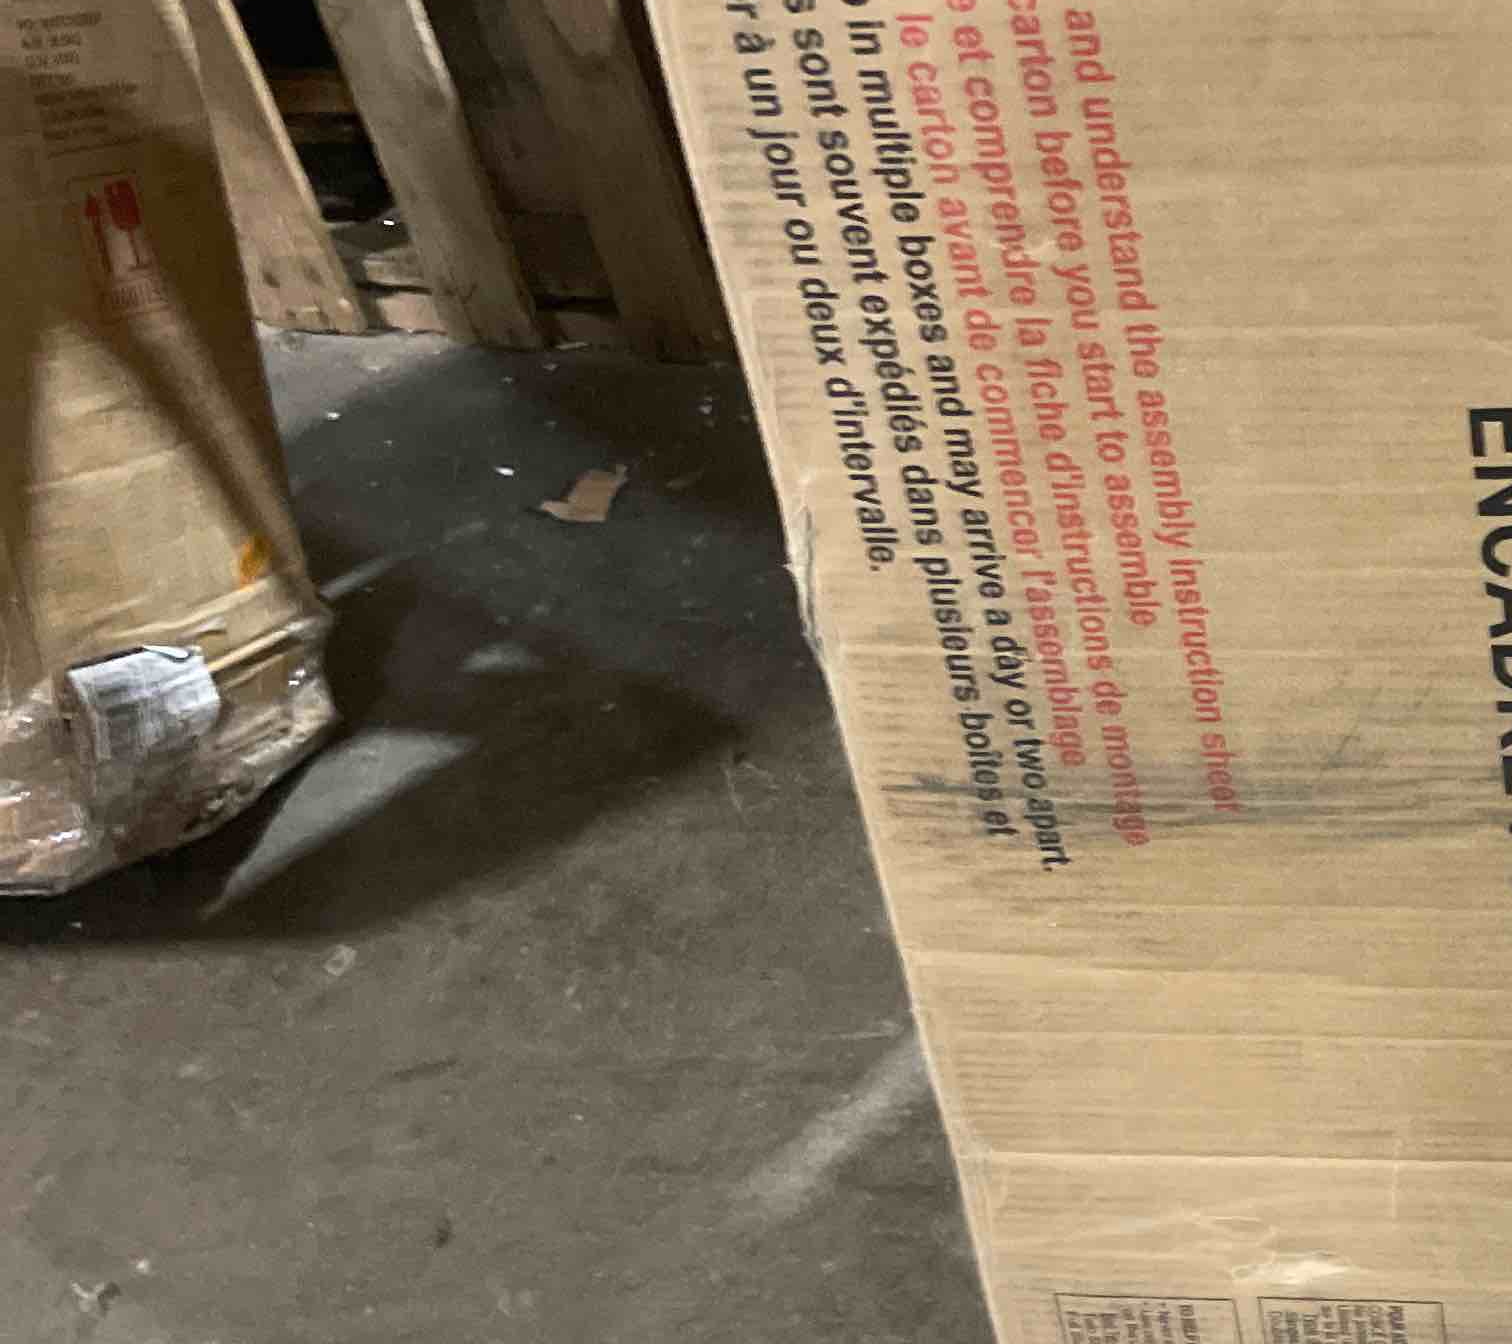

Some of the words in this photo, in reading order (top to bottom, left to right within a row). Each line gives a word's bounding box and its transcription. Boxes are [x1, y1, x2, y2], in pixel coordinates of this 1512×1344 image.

[732, 31, 773, 54] à
[846, 21, 884, 55] in
[896, 15, 934, 46] le
[953, 26, 989, 62] et
[1058, 10, 1110, 82] and
[742, 68, 782, 116] un
[793, 29, 846, 117] sont
[858, 70, 925, 222] multiple
[906, 62, 963, 183] carton
[746, 128, 810, 207] jour
[816, 131, 888, 283] souvent
[961, 76, 1038, 305] comprendre
[1032, 131, 1086, 251] before
[1080, 97, 1162, 310] understand
[783, 218, 820, 265] ou
[936, 197, 987, 297] avant
[797, 279, 849, 365] deux
[895, 234, 953, 342] boxes
[1052, 265, 1099, 331] you
[964, 309, 1002, 351] de
[1016, 318, 1050, 347] la
[1126, 324, 1164, 378] the
[855, 295, 926, 452] expédiés
[925, 355, 973, 416] and
[1024, 359, 1065, 441] fiche
[1075, 343, 1124, 419] start
[825, 377, 898, 572] d'intervalle.
[936, 429, 986, 497] may
[974, 363, 1039, 559] commencer
[1093, 432, 1128, 462] to
[1135, 390, 1193, 548] assembly
[901, 465, 947, 546] dans
[961, 508, 1005, 599] arrive
[1043, 452, 1108, 670] d'instructions
[1102, 474, 1161, 625] assemble
[912, 558, 986, 702] plusieurs
[983, 609, 1011, 626] a
[1166, 559, 1227, 723] instruction
[989, 636, 1030, 688] day
[1024, 570, 1087, 767] l'assemblage
[1090, 681, 1130, 714] de
[1005, 699, 1034, 729] or
[1013, 739, 1048, 790] two
[1104, 725, 1152, 847] montage
[983, 810, 1018, 836] et
[1024, 799, 1072, 872] apart.
